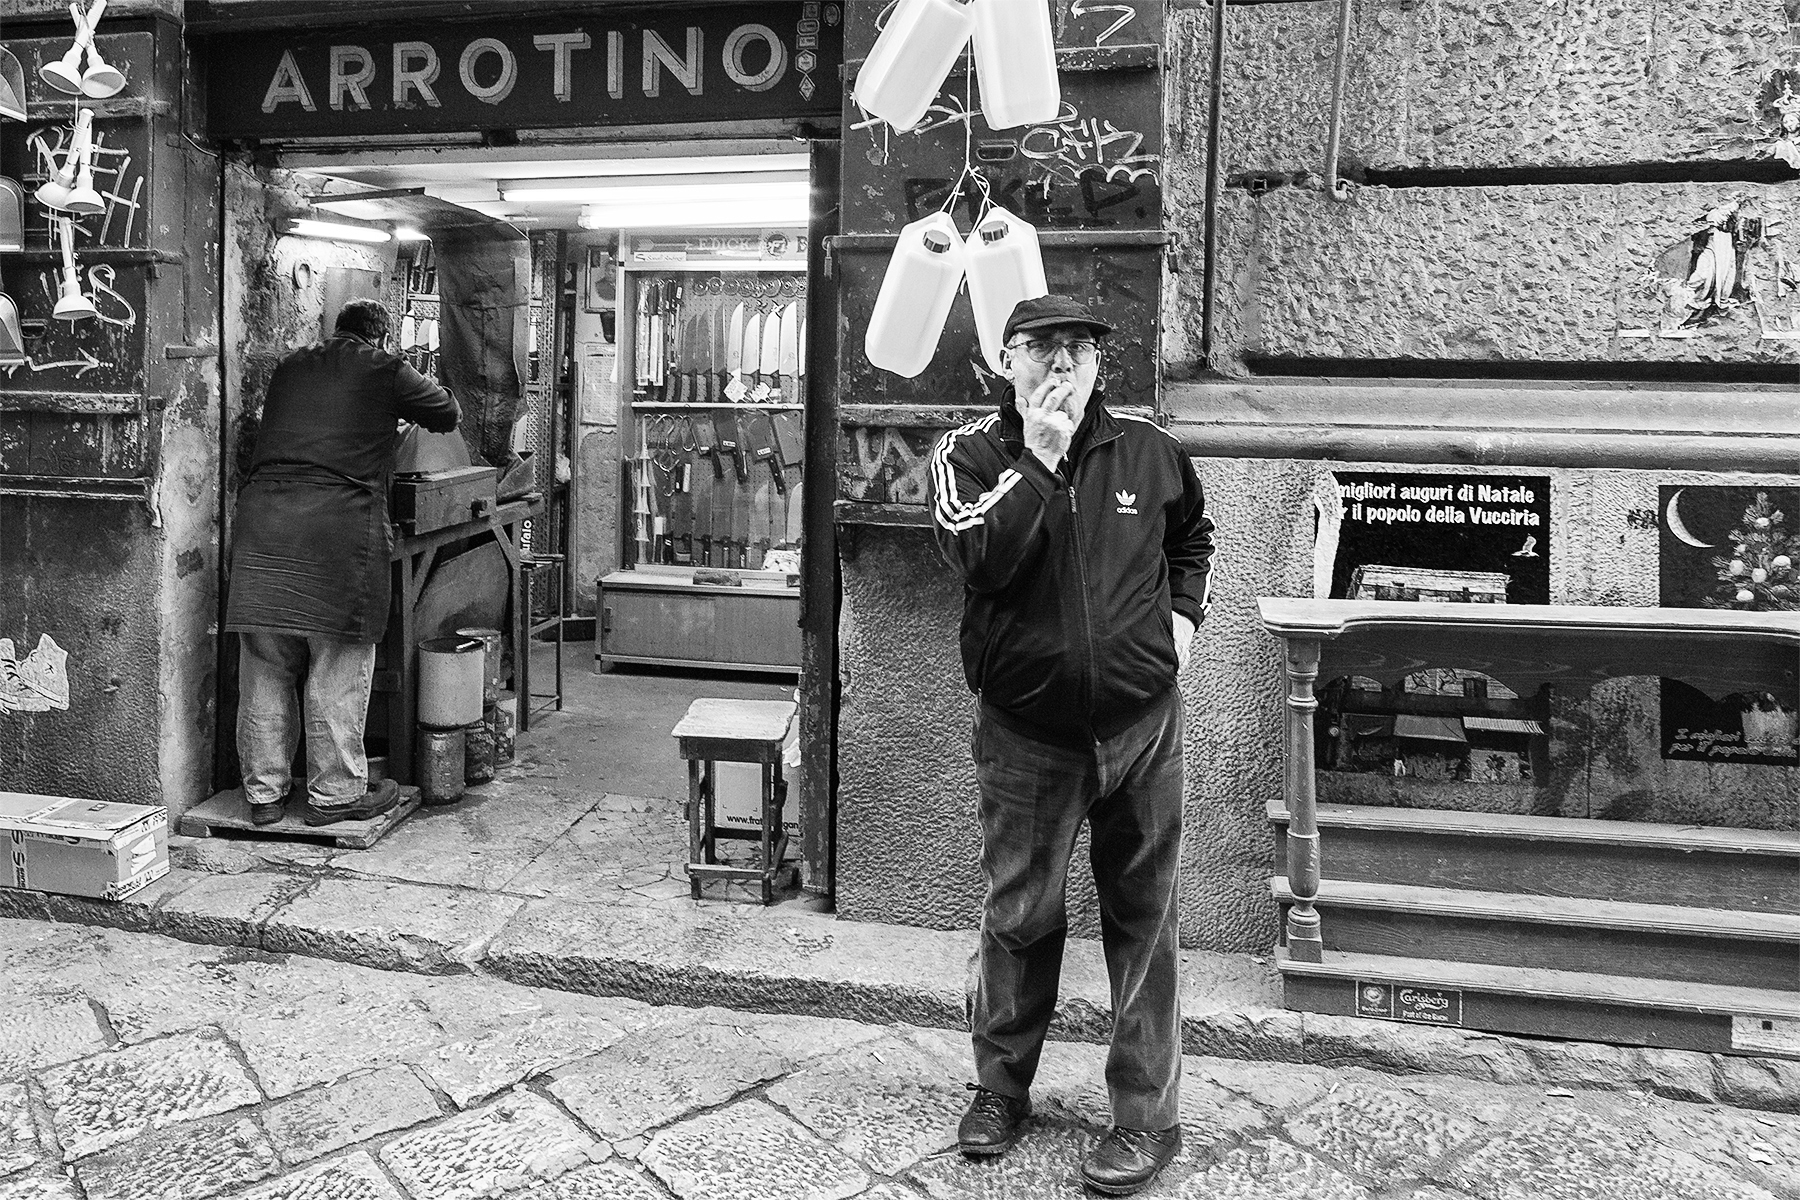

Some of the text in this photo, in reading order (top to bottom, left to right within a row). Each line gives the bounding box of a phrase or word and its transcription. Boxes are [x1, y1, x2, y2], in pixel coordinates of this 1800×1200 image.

[261, 23, 788, 113] ARROTINO
[1339, 482, 1535, 503] migliori auguri di Natale
[1116, 506, 1138, 515] adidas
[1352, 503, 1362, 520] il
[1366, 504, 1421, 524] popolo
[1425, 505, 1465, 523] della
[1469, 507, 1541, 526] Vucciria
[520, 519, 532, 551] ufalo
[1400, 988, 1449, 1010] Carlsberg
